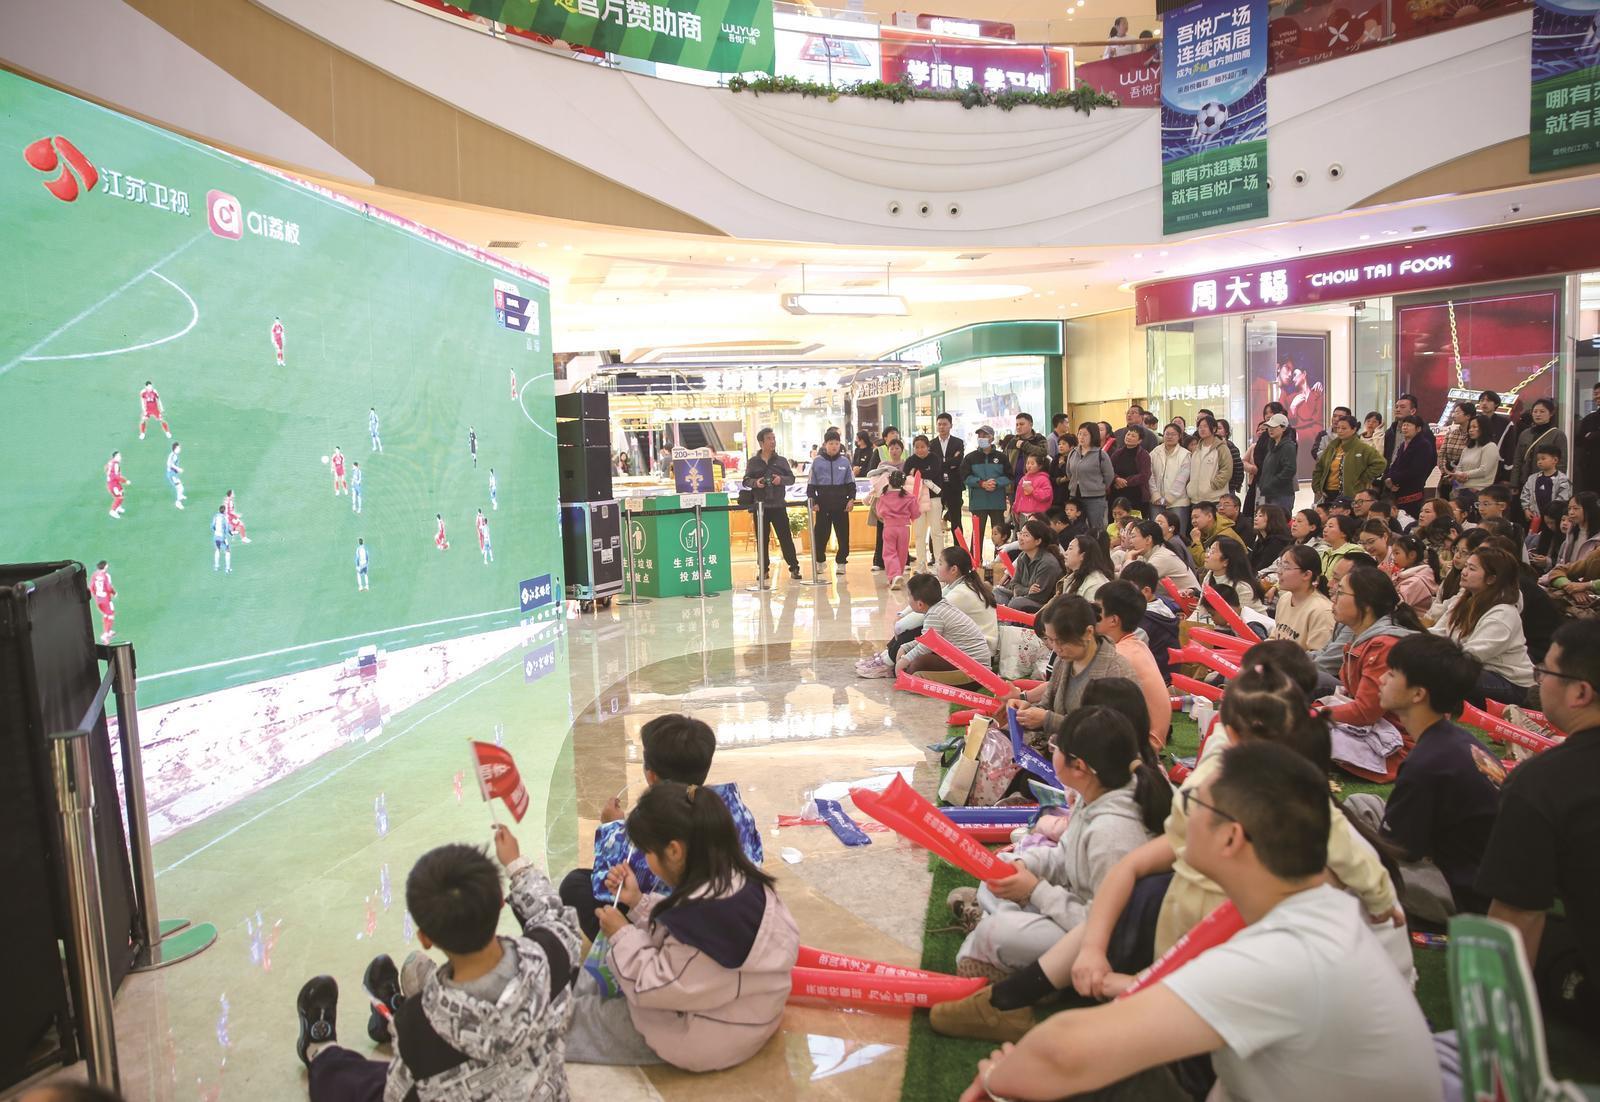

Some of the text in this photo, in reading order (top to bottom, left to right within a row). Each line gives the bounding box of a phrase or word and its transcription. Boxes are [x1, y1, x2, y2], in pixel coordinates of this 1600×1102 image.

[1177, 4, 1251, 46] 吾悦广场
[1177, 26, 1251, 67] 连续两届
[1171, 153, 1258, 185] 哪有苏超赛场
[1171, 173, 1259, 206] 就有吾悦广场
[101, 167, 191, 217] 江苏卫视
[1191, 268, 1289, 313] 周大福
[1311, 255, 1452, 288] CHOW TAI FOOK
